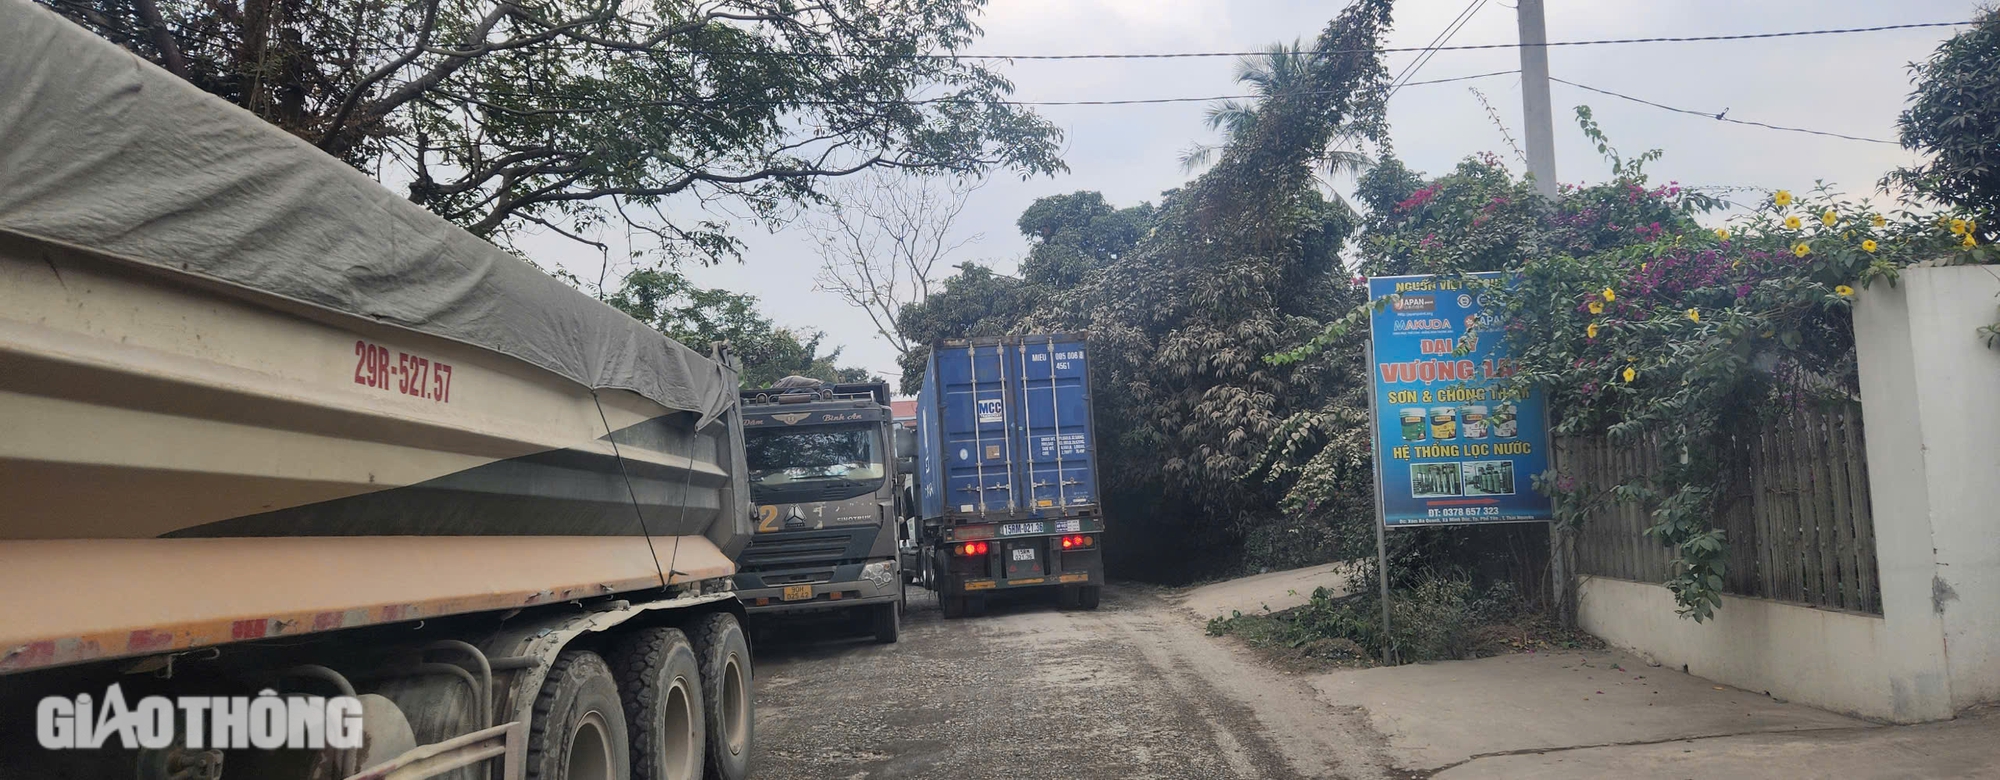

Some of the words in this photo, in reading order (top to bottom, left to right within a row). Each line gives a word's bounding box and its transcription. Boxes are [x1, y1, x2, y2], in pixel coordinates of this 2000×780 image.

[1393, 318, 1452, 331] MAKUDA
[1421, 338, 1453, 356] ĐẠI
[355, 340, 452, 403] 29R-527.57
[1380, 358, 1475, 385] VƯỢNG
[1388, 390, 1417, 404] SƠN
[1422, 390, 1432, 403] &
[979, 402, 1002, 414] MCC
[1393, 444, 1410, 460] HỆ
[1415, 441, 1460, 458] THỐNG
[1464, 443, 1489, 460] LỌC
[1494, 442, 1531, 455] NƯỚC
[1442, 508, 1464, 516] 0378
[1465, 507, 1481, 515] 657
[1483, 506, 1499, 515] 323
